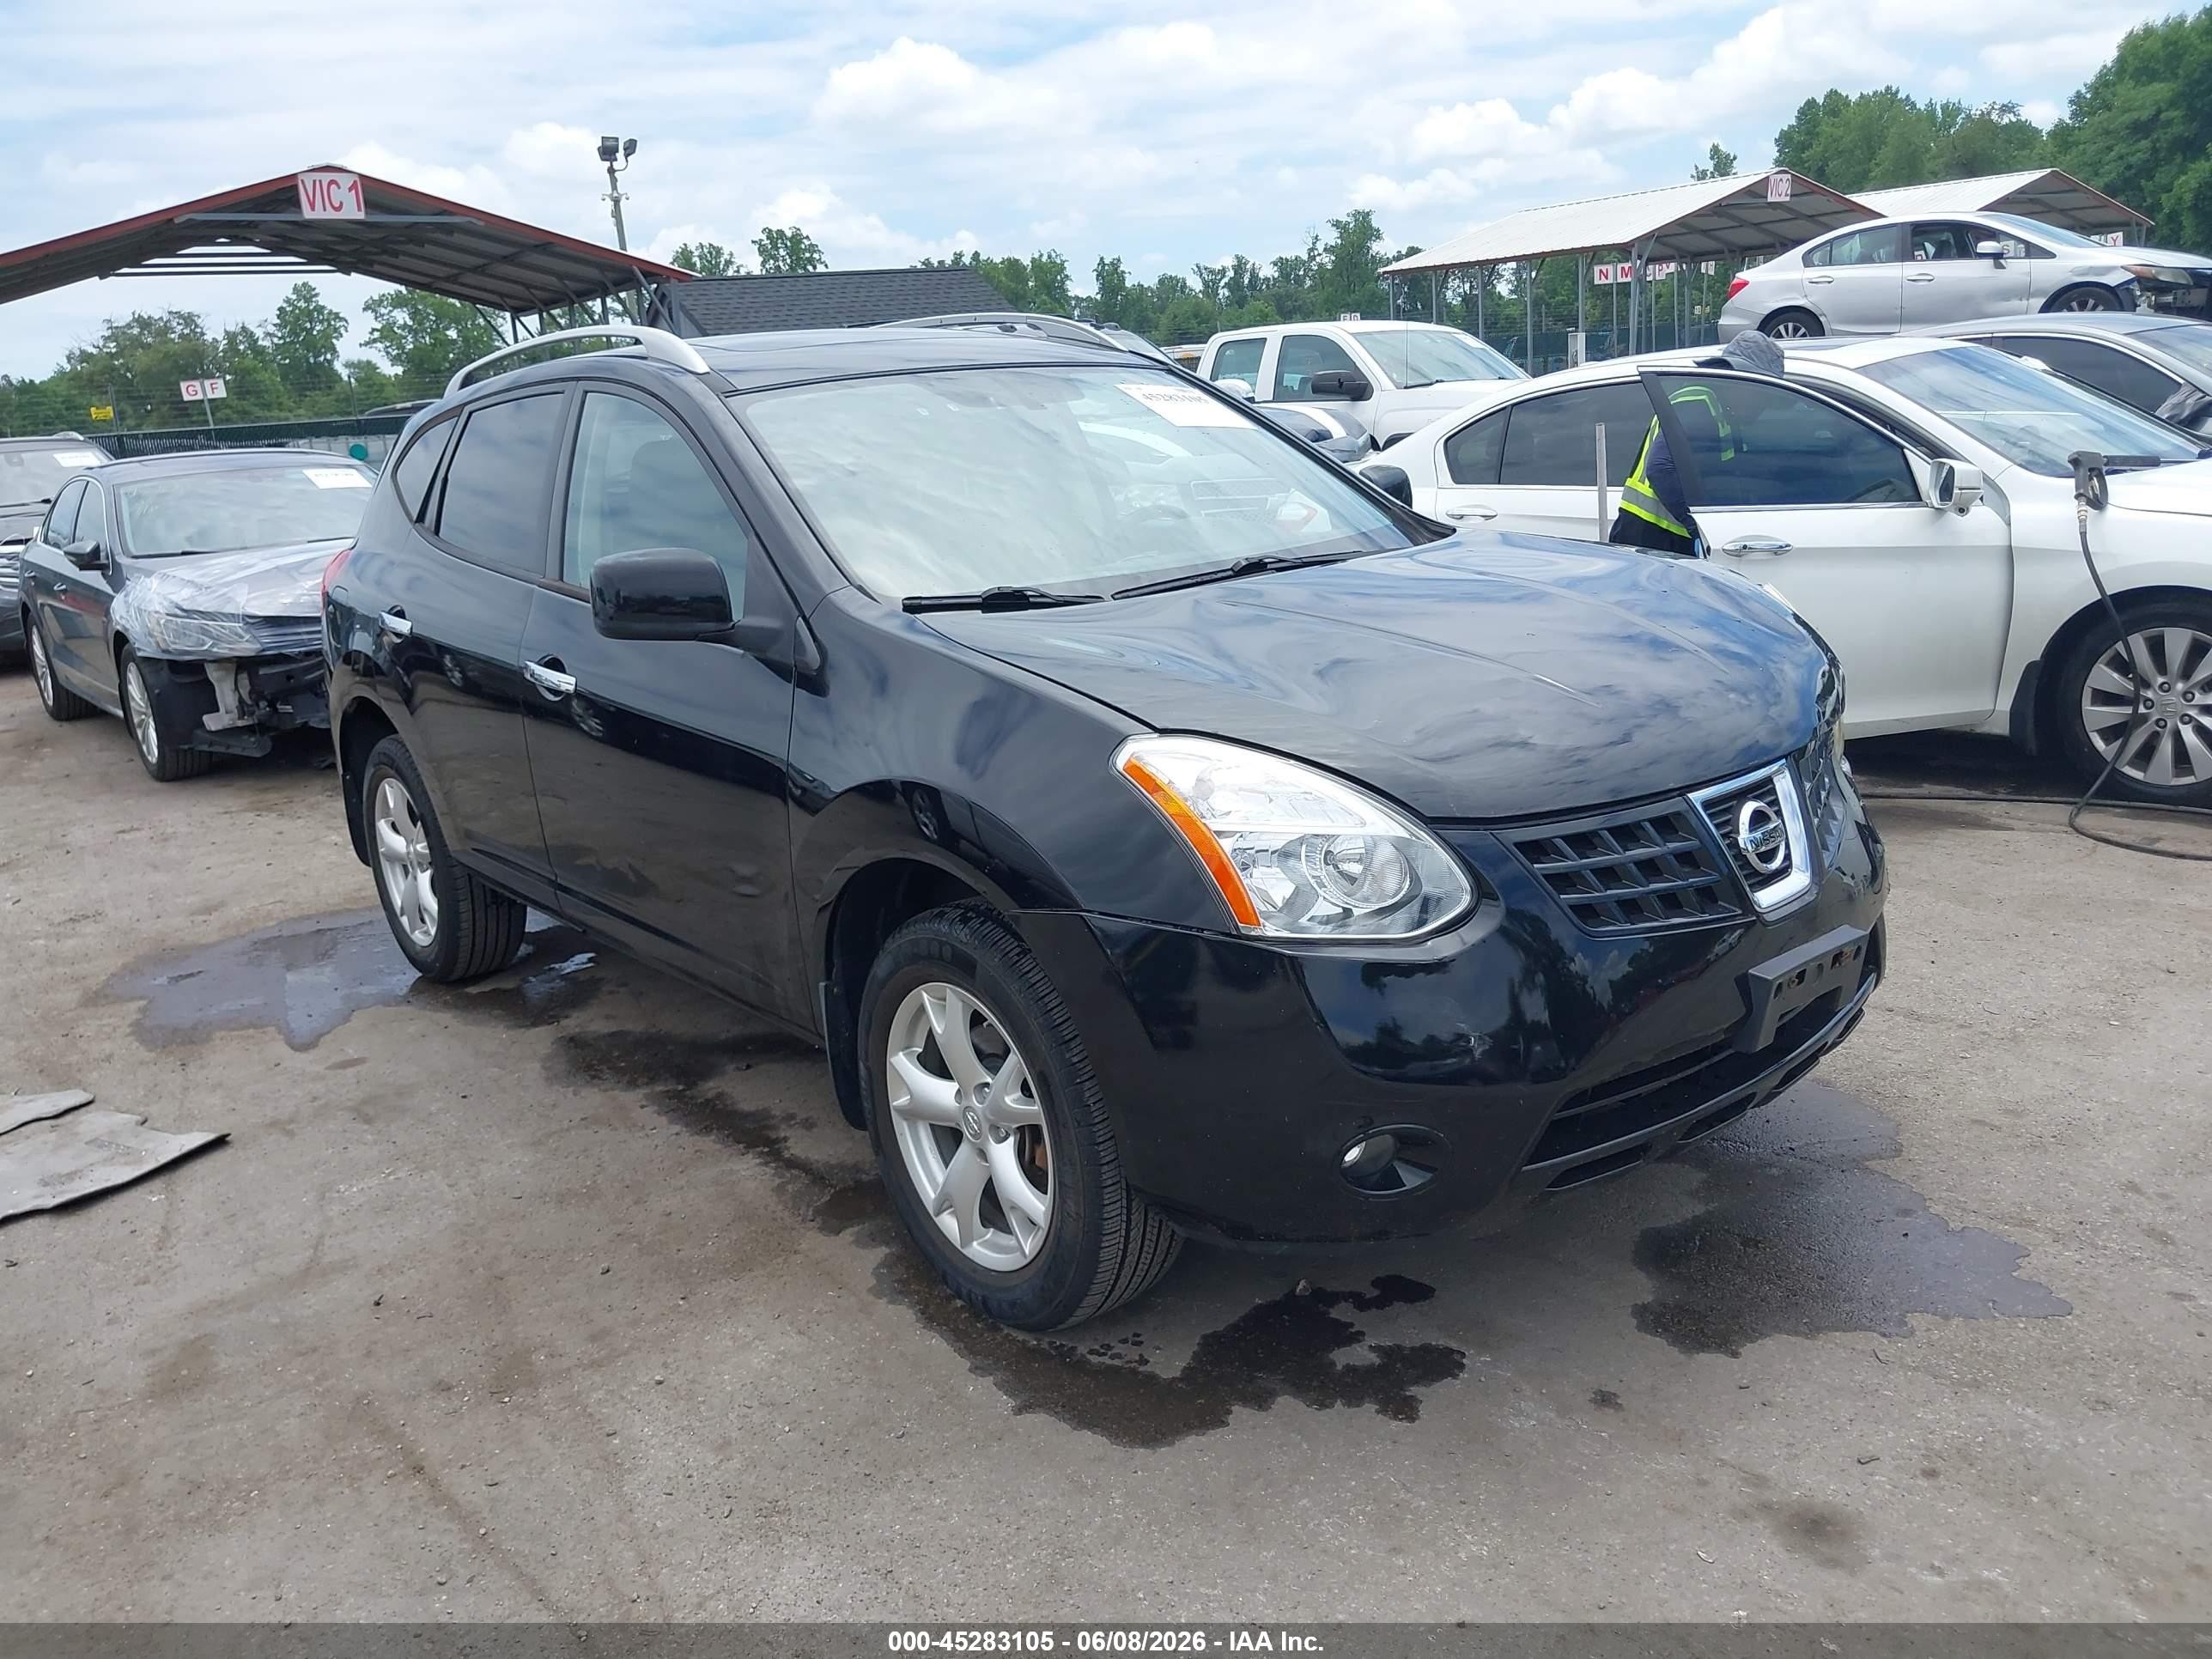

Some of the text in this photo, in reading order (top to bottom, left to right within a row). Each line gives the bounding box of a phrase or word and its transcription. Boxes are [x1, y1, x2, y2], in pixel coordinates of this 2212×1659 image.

[1770, 178, 1790, 198] VIC 2
[301, 179, 362, 212] VIC 1
[1599, 267, 1608, 281] N
[1620, 265, 1633, 279] M
[185, 384, 198, 397] G
[210, 382, 218, 394] F
